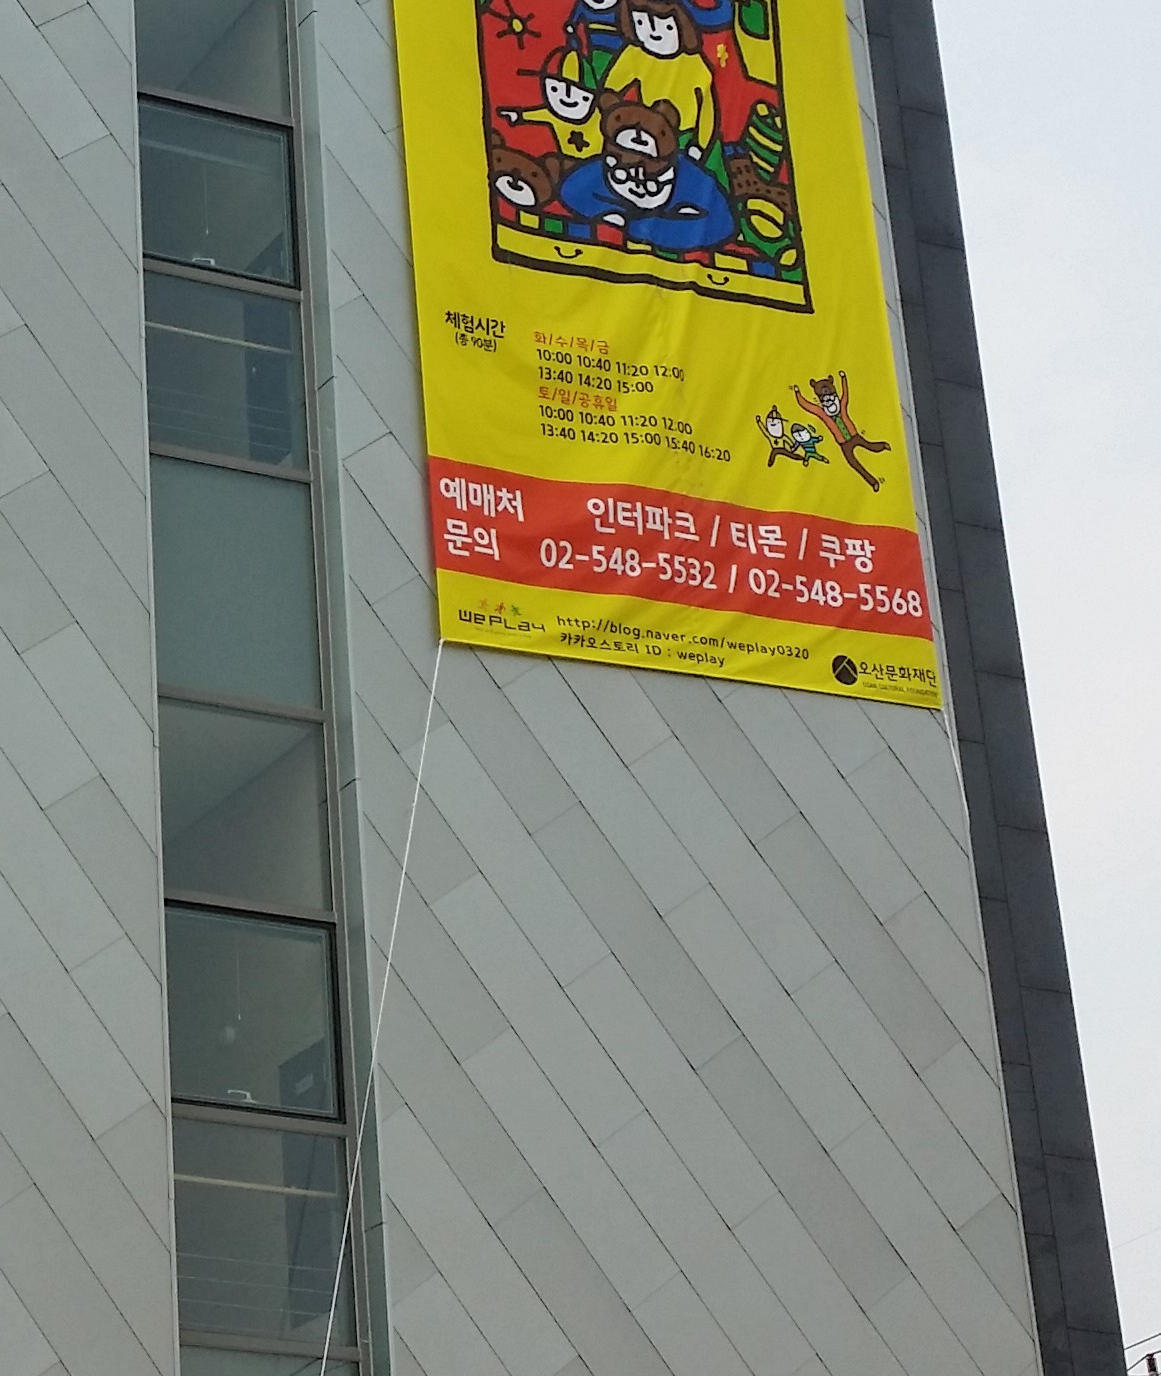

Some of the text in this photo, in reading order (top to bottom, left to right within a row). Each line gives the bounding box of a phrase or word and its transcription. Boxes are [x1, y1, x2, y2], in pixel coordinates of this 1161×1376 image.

[445, 310, 506, 339] 체험시간
[536, 349, 685, 382] 10:00 10:40 11:20 12:00
[538, 366, 654, 394] 13:40 14:20 15:00
[539, 405, 693, 435] 10:00 10:40 11:20 12:00
[540, 423, 731, 463] 13:40 14:20 15:00 15:40 16:20
[439, 477, 525, 522] 예매처
[586, 497, 700, 541] 인터파크
[730, 522, 788, 560] 티몬
[819, 534, 876, 574] 쿠팡
[443, 518, 500, 561] 문의
[539, 538, 718, 590] 02-548-5532
[748, 567, 923, 618] 02-548-5568
[560, 632, 639, 654] 카카오스토리
[646, 645, 662, 656] ID
[677, 650, 725, 668] weplay
[859, 661, 937, 688] 오산문화재단
